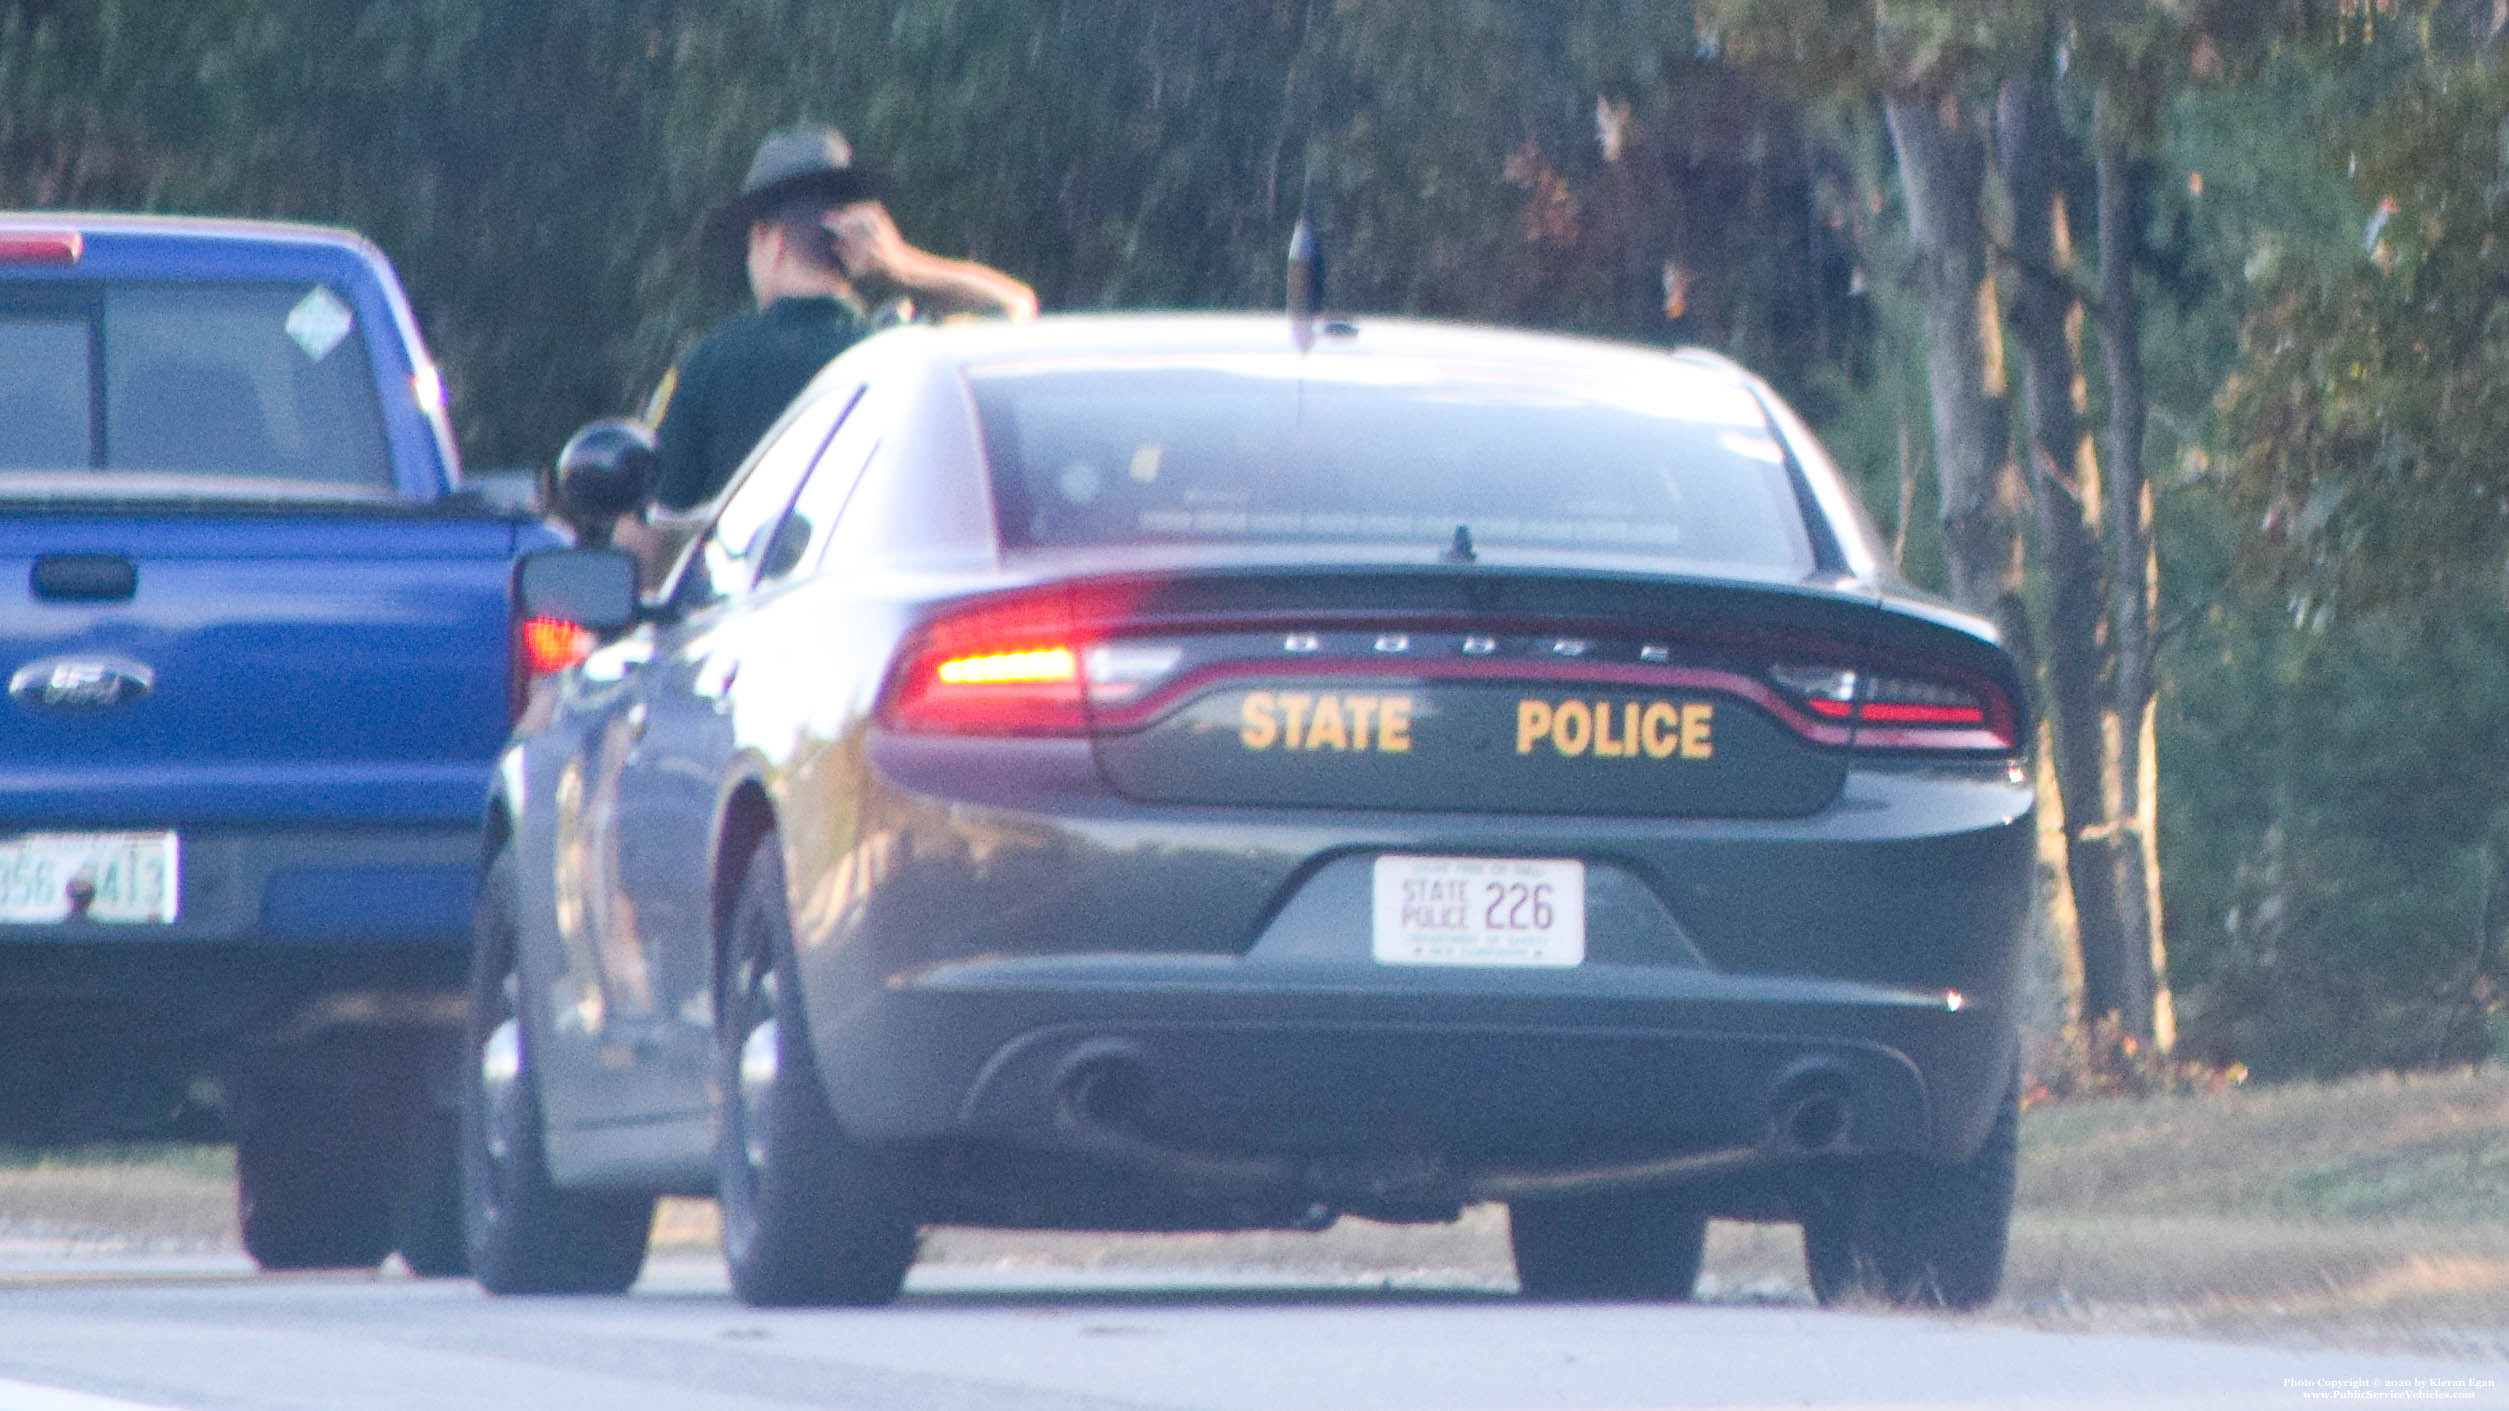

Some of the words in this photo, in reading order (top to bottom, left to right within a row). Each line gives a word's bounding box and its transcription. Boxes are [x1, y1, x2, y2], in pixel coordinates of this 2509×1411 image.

[1241, 692, 1413, 752] STATE
[1516, 700, 1713, 758] POLICE
[1402, 879, 1469, 902] STATE
[1485, 881, 1553, 930] 226
[1402, 905, 1470, 929] POLICE
